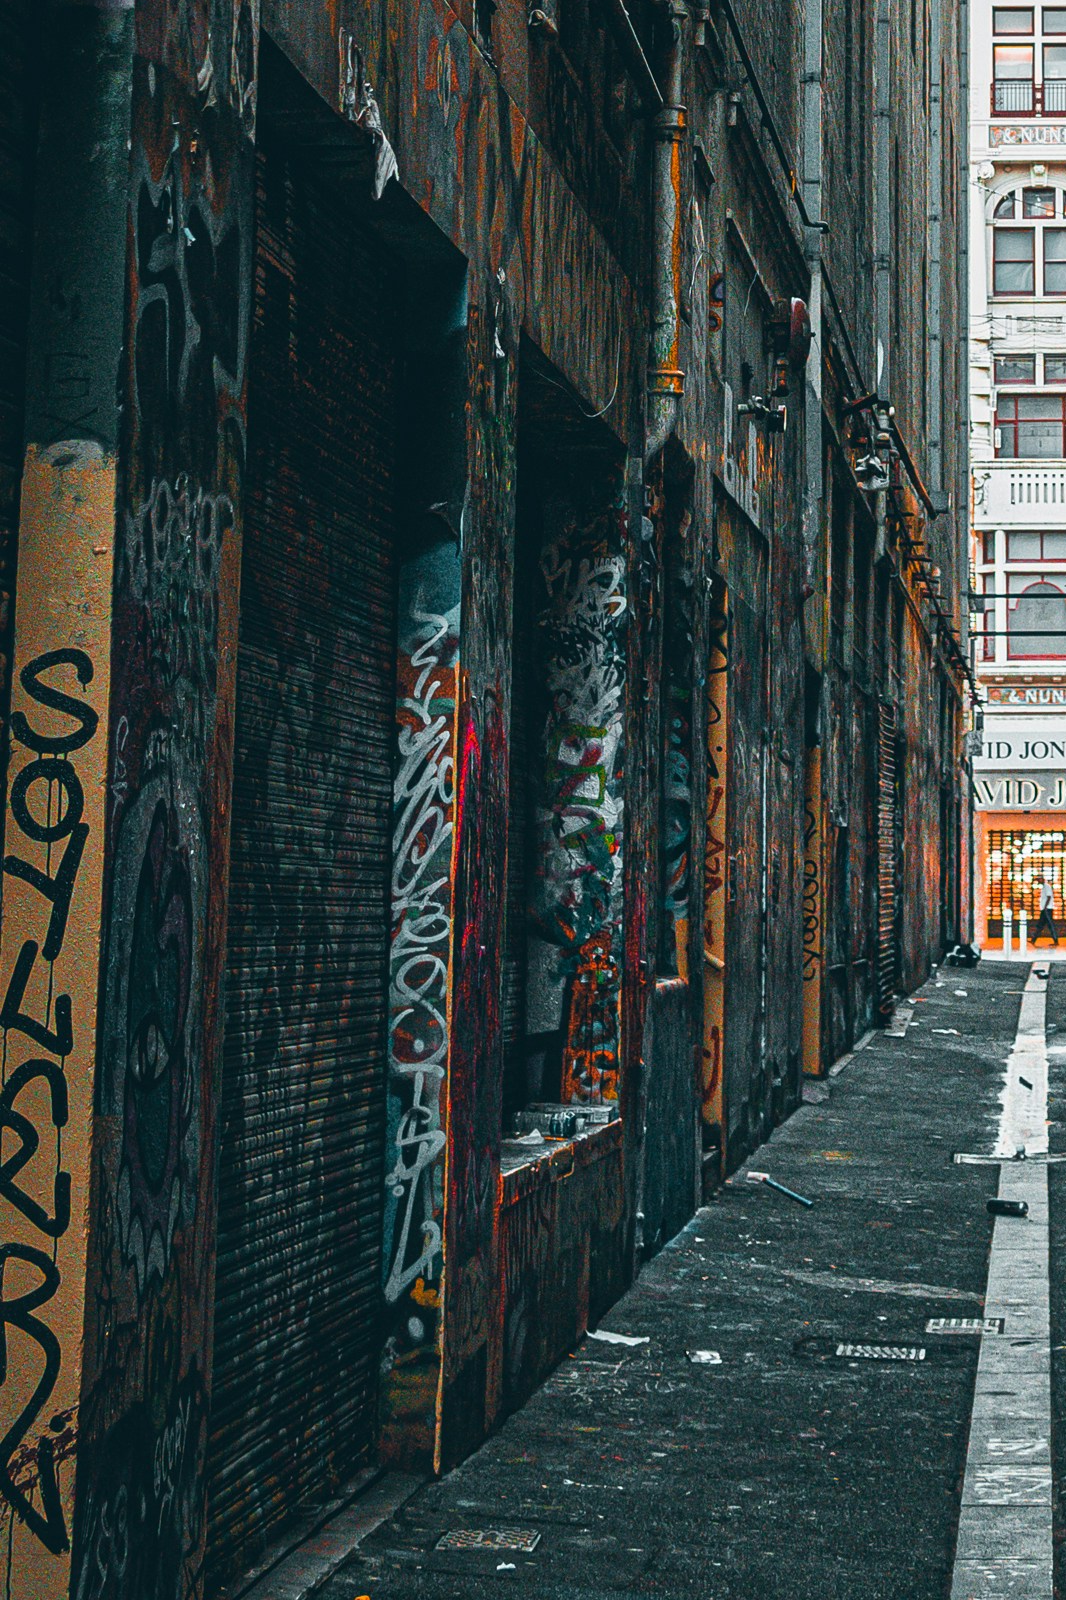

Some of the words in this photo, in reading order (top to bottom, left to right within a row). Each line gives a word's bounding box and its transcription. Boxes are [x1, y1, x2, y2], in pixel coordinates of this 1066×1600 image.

[1003, 127, 1017, 144] &
[1008, 689, 1020, 703] &
[982, 741, 1012, 759] ID
